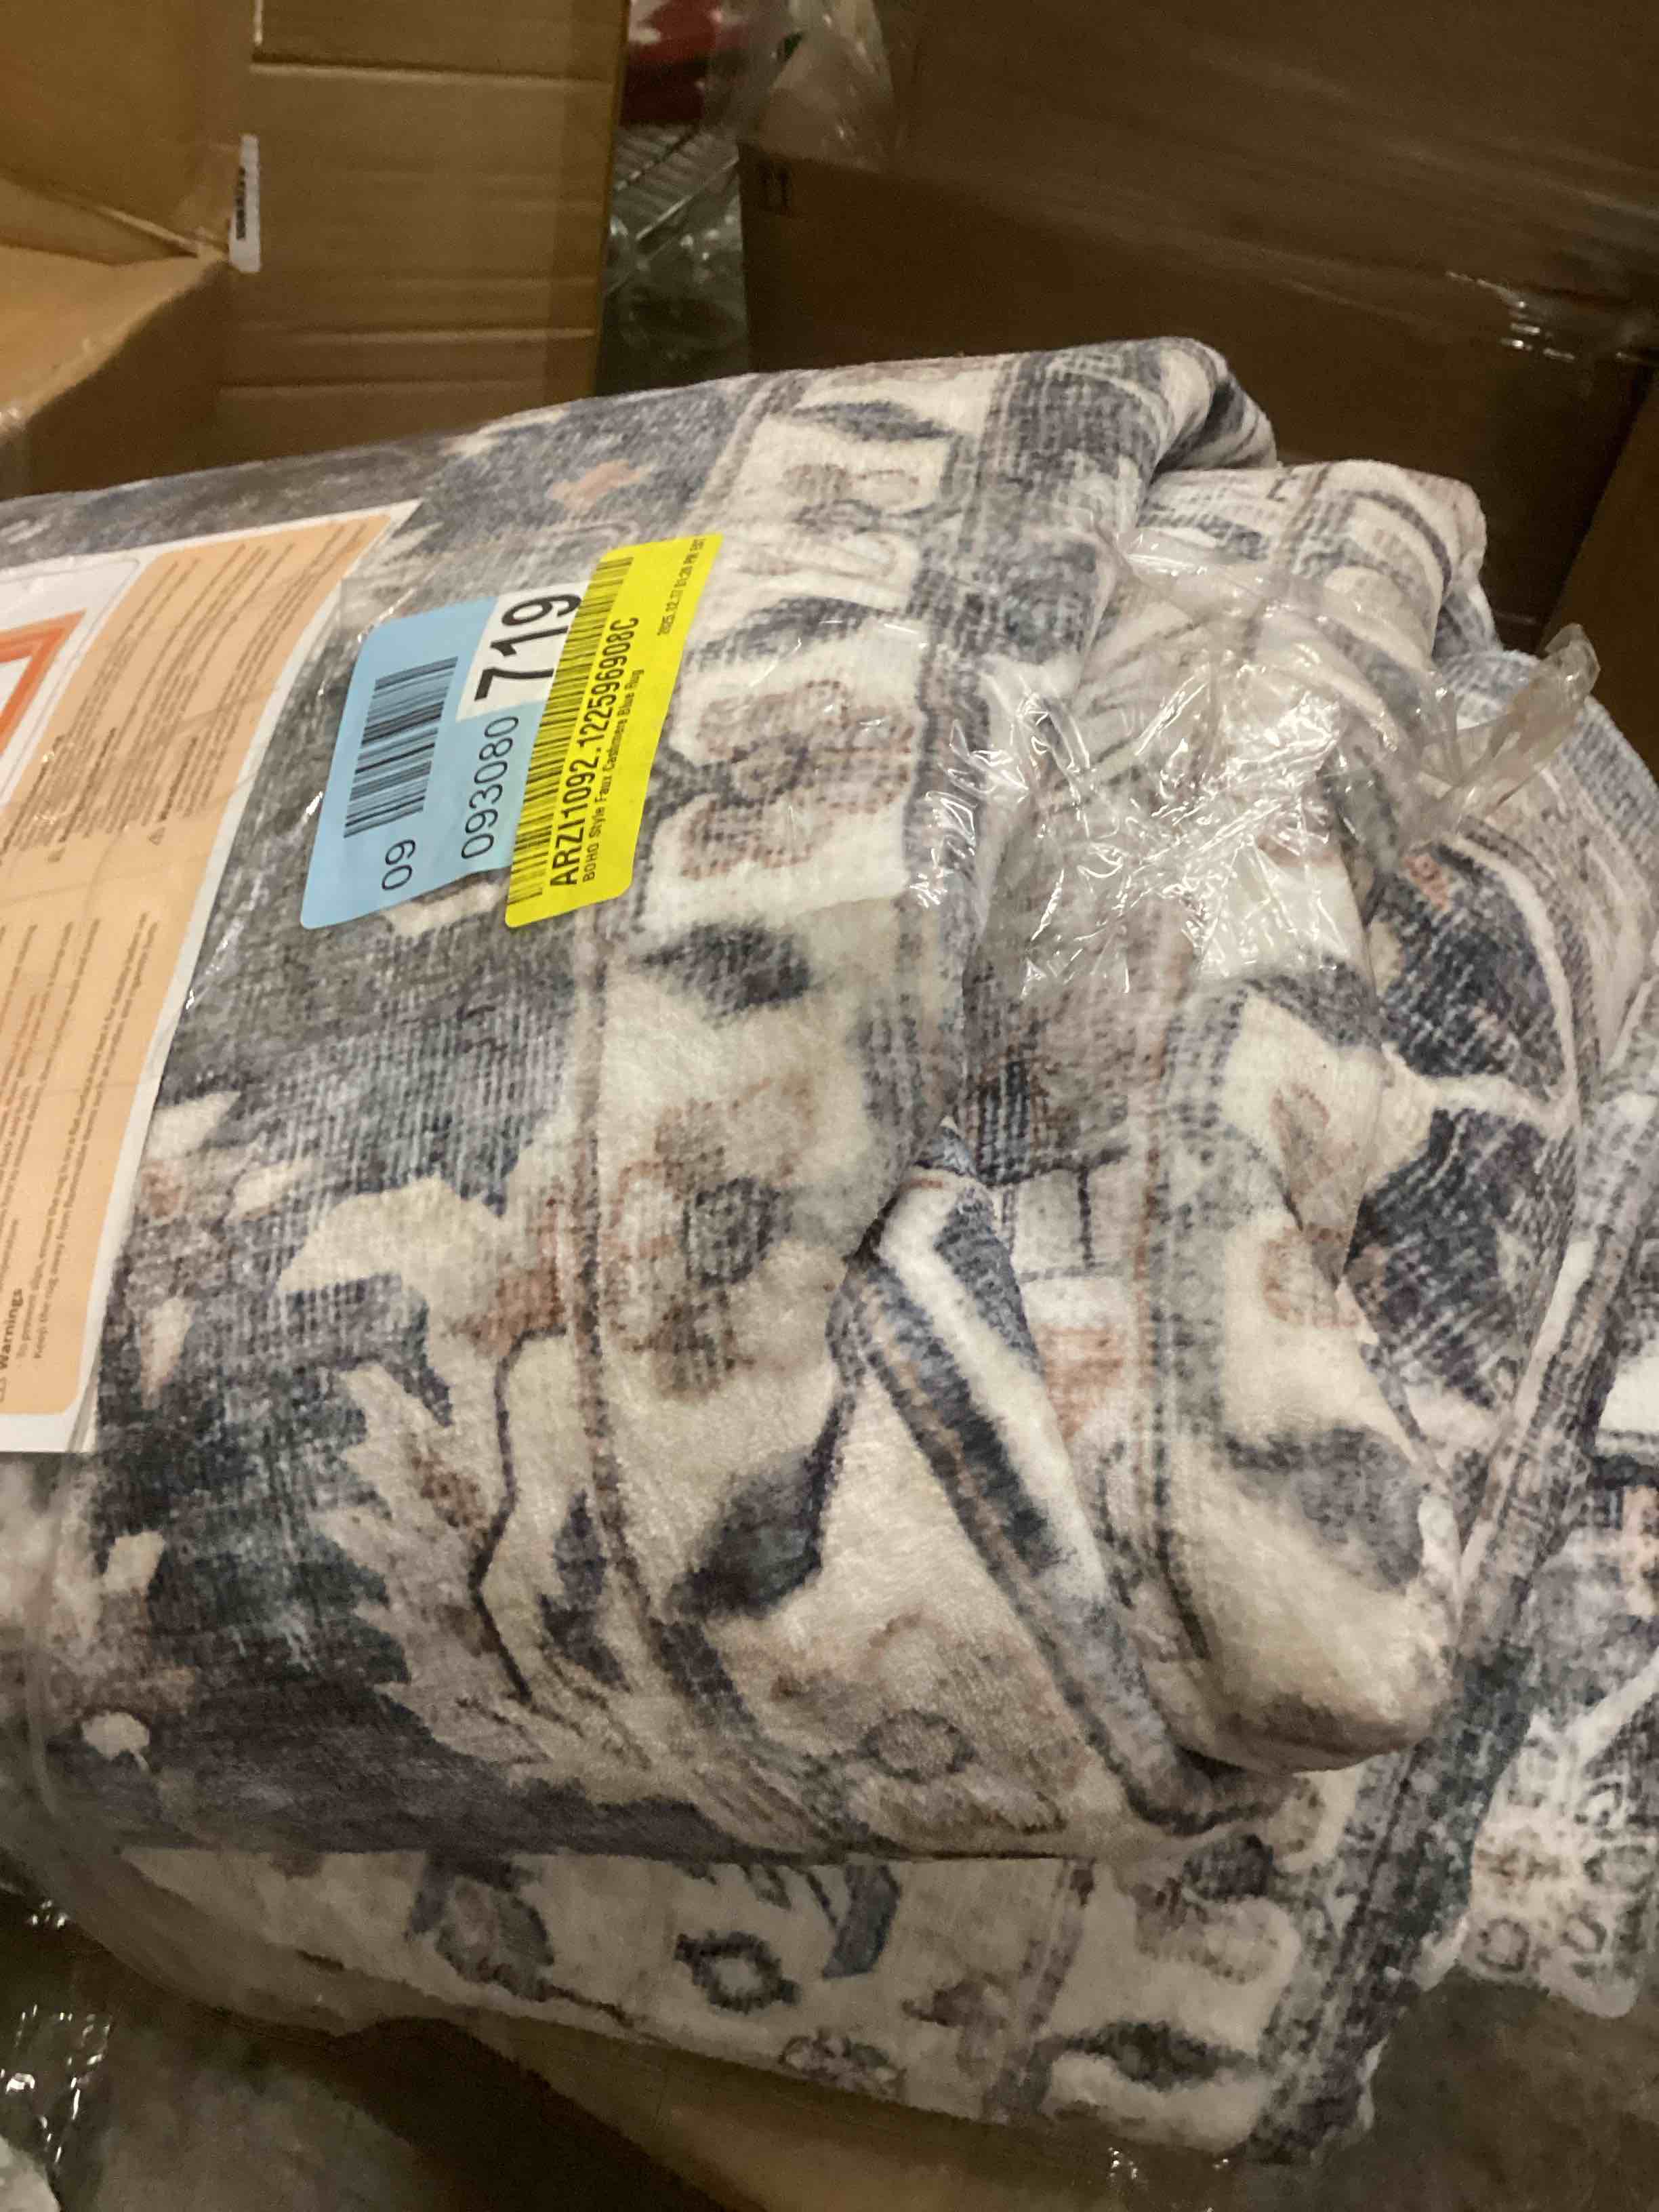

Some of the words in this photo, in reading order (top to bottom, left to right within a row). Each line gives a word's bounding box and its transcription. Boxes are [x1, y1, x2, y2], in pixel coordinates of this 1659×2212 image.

[474, 594, 583, 701] 719
[617, 693, 634, 717] Blue
[550, 617, 639, 886] ARZI1092.122596908C
[461, 716, 519, 860] 093080
[594, 775, 613, 803] Faux
[589, 806, 607, 838] Style
[381, 838, 416, 891] 09
[582, 842, 600, 882] BOHO
[0, 1288, 24, 1370] Warnings
